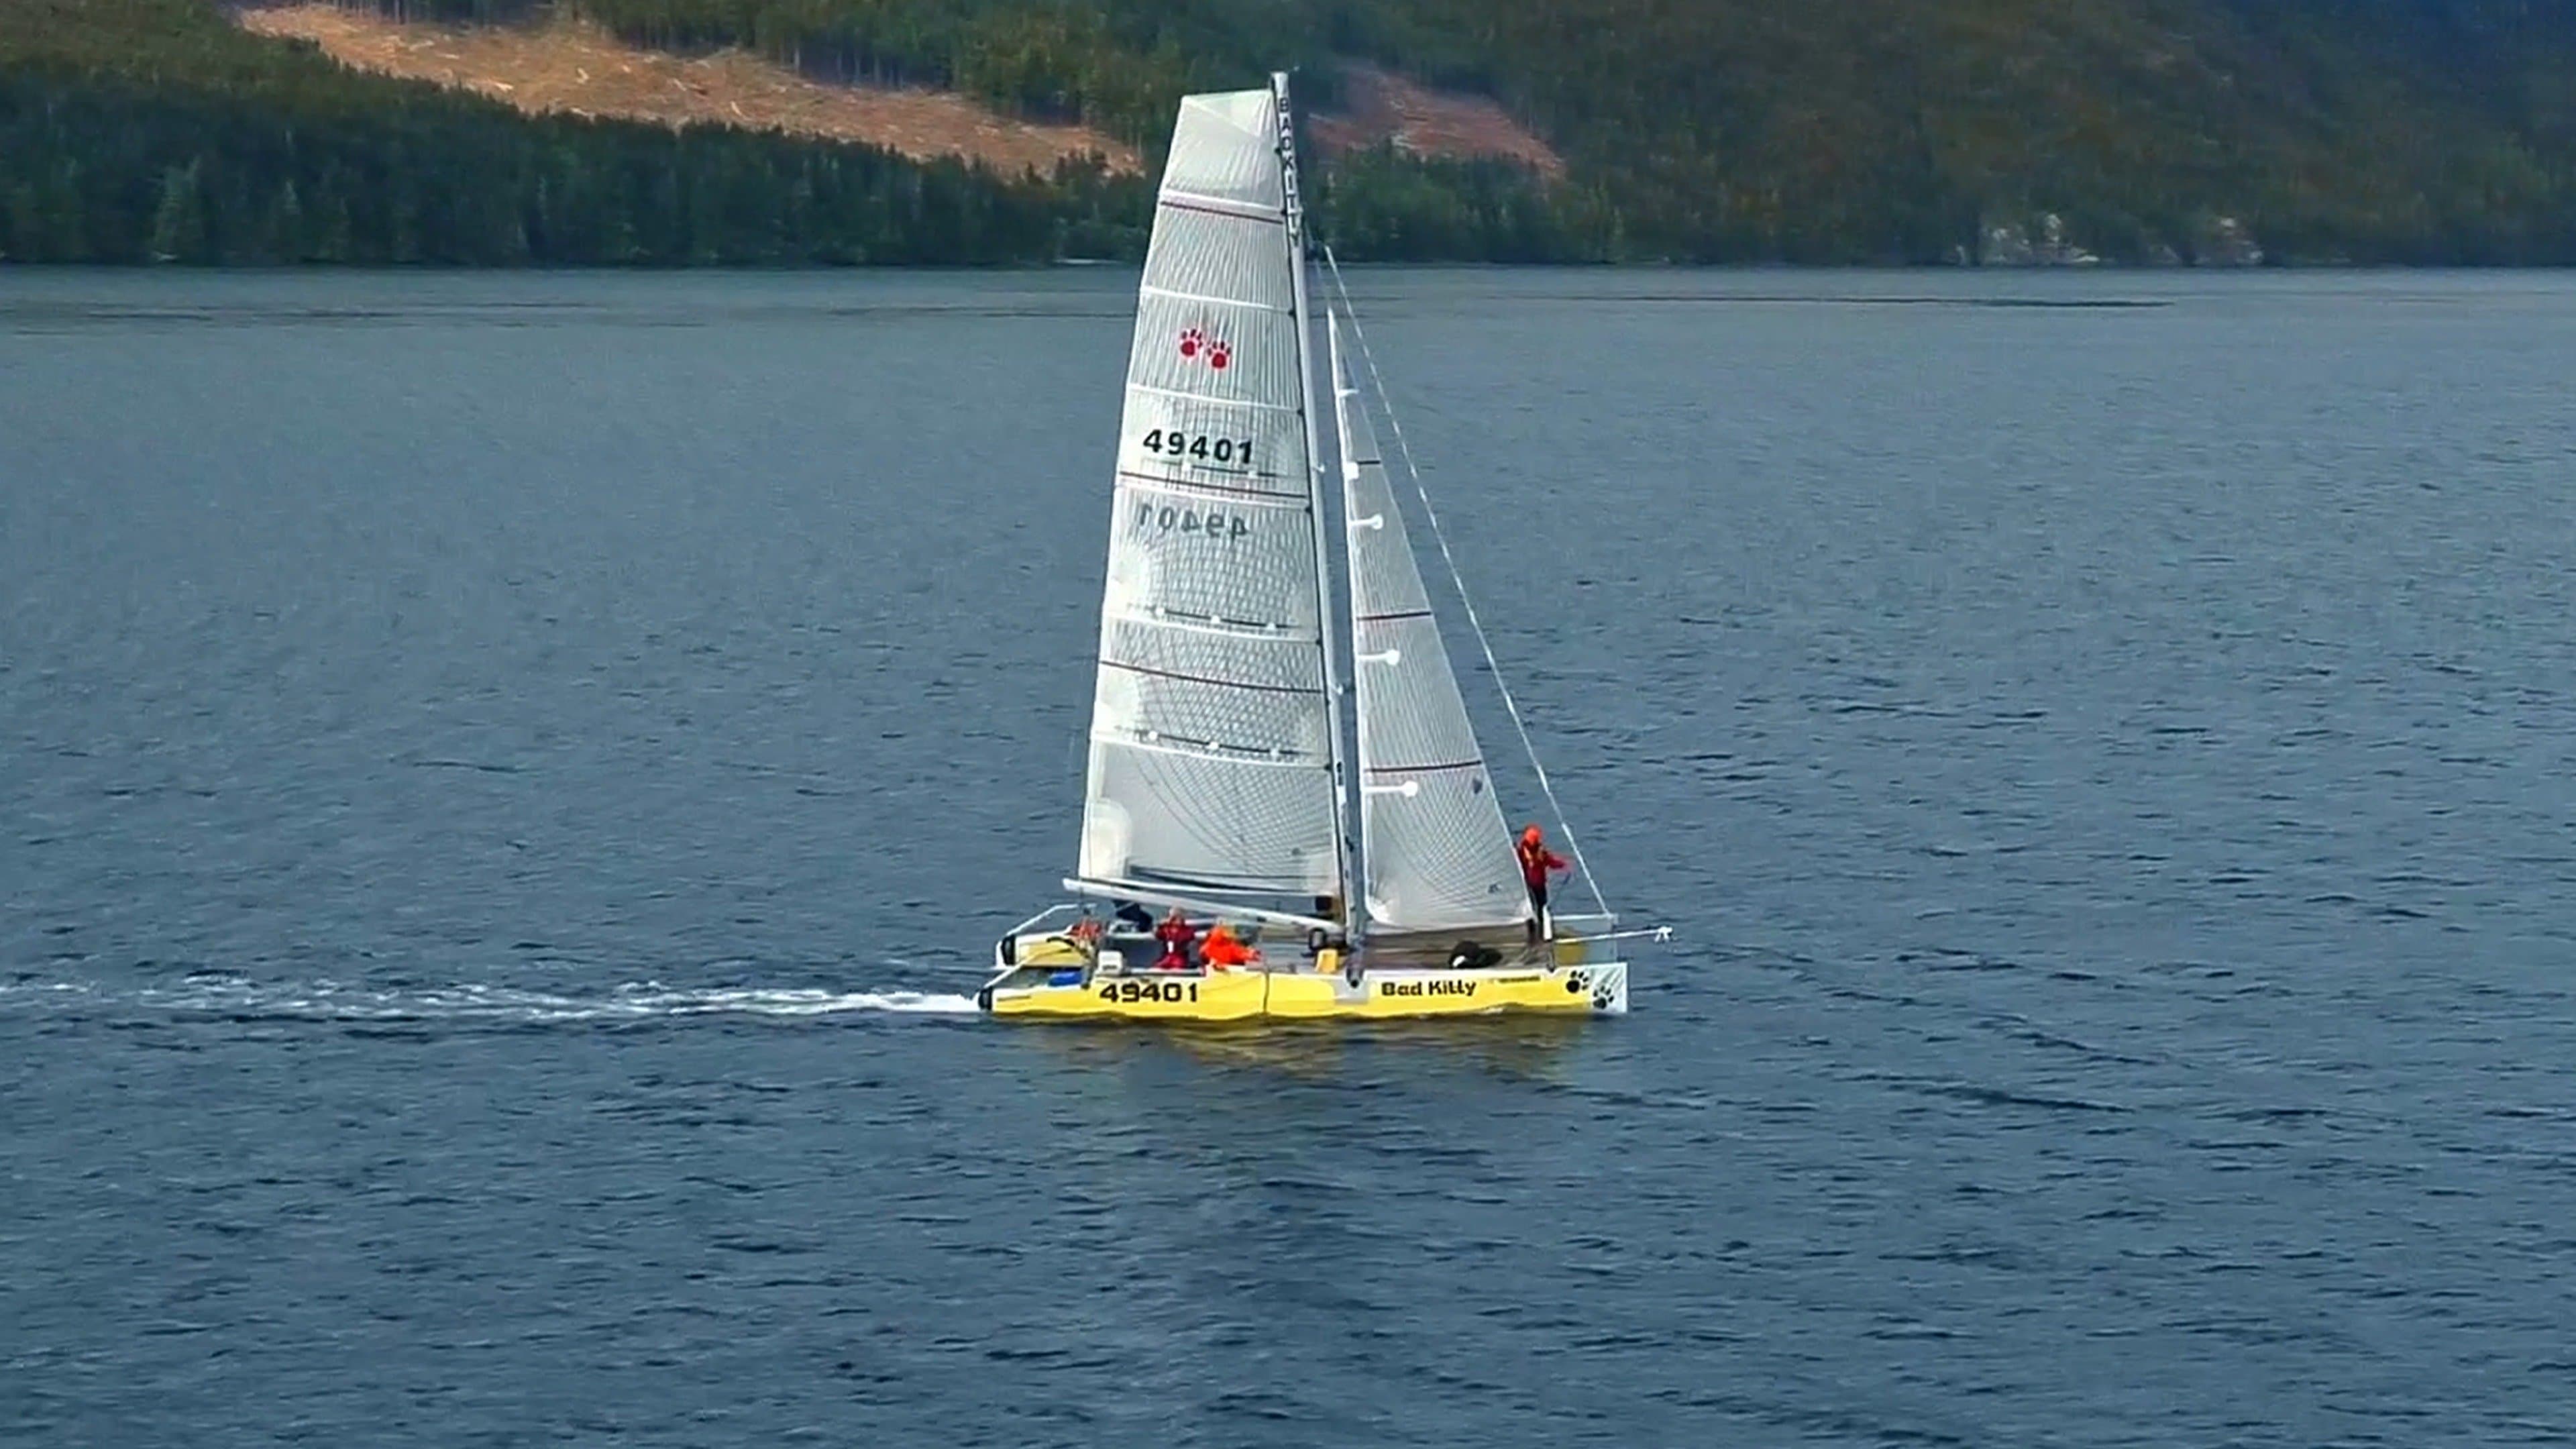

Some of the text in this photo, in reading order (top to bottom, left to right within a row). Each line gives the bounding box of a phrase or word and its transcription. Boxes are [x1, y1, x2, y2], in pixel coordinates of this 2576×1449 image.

[1143, 429, 1252, 464] 49401
[1099, 983, 1197, 1003] 49401
[1381, 979, 1477, 996] Bad Kitty
